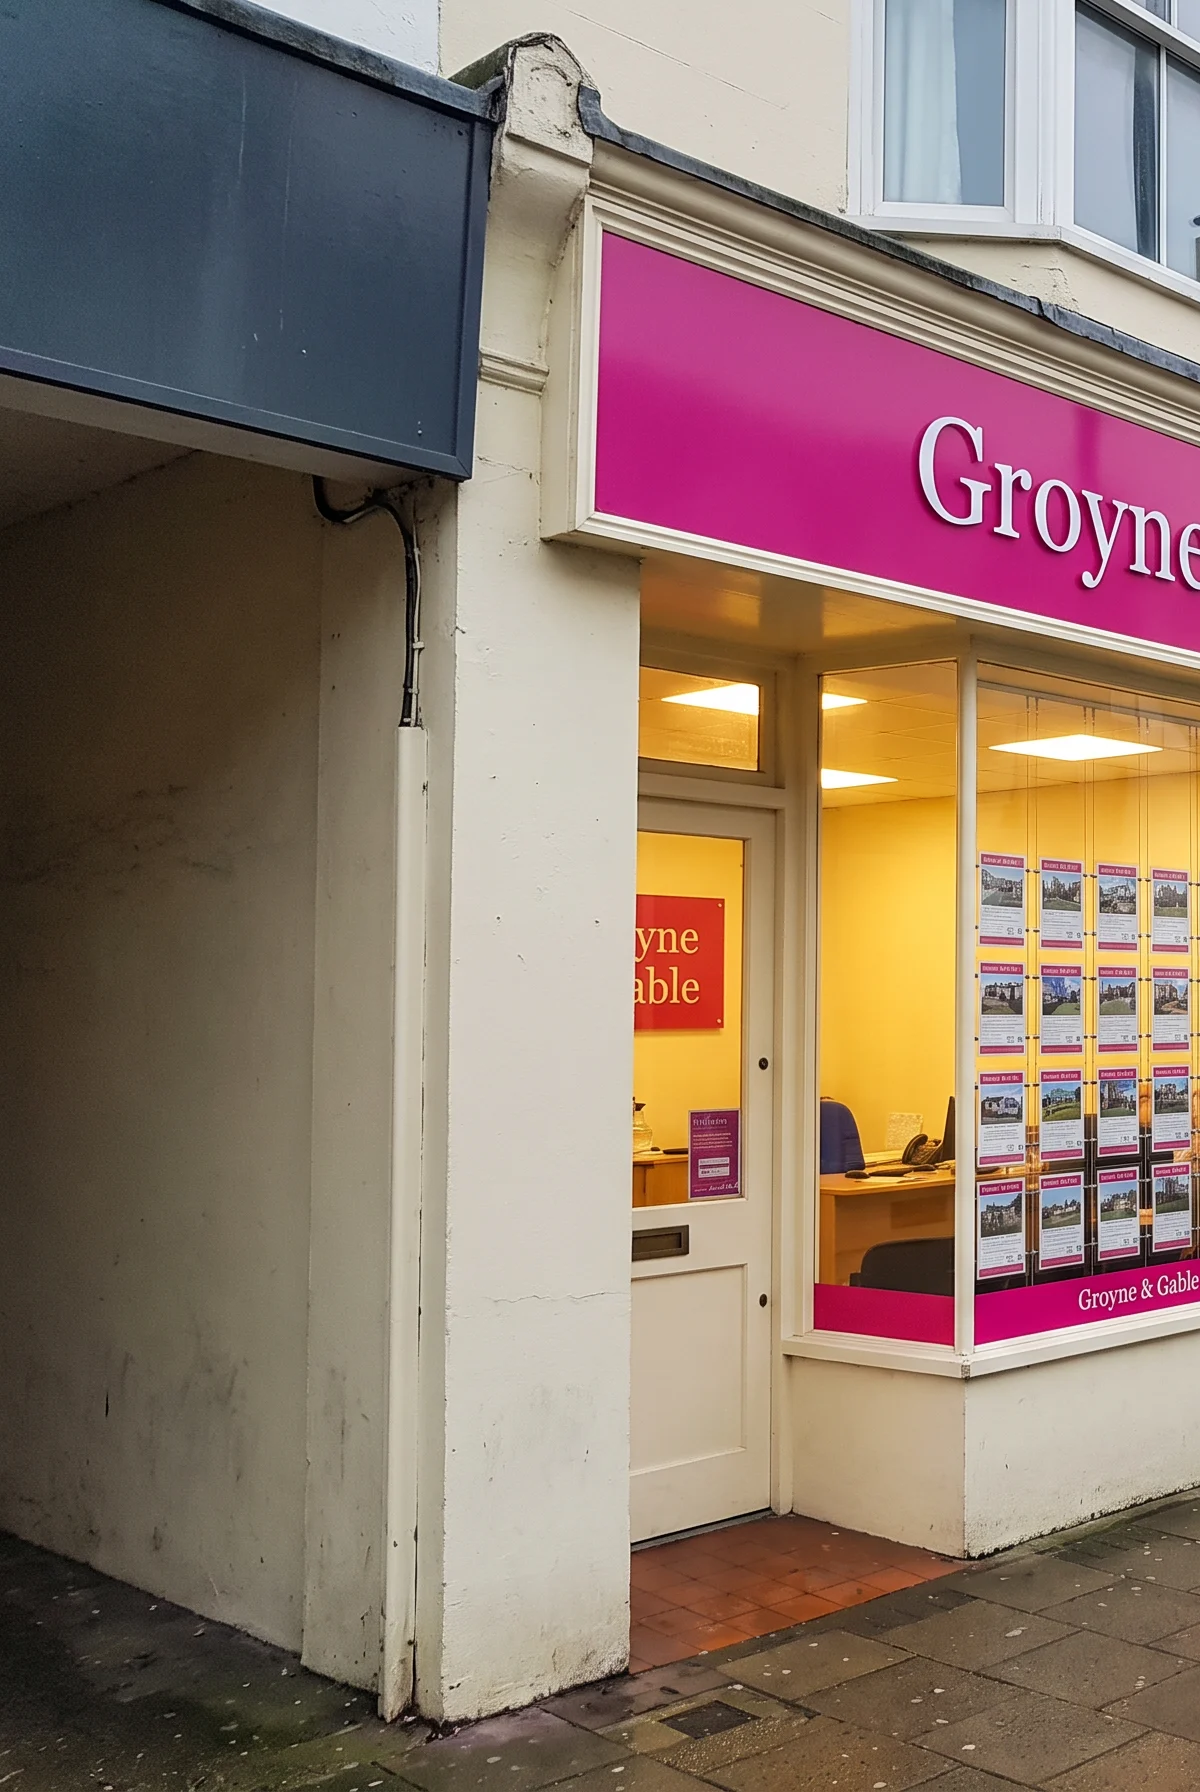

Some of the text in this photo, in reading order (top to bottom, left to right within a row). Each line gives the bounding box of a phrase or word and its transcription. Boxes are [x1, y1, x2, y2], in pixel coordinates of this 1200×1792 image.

[634, 927, 699, 963] yne
[633, 965, 700, 1005] able
[1078, 1269, 1200, 1311] Groyne & Gable
